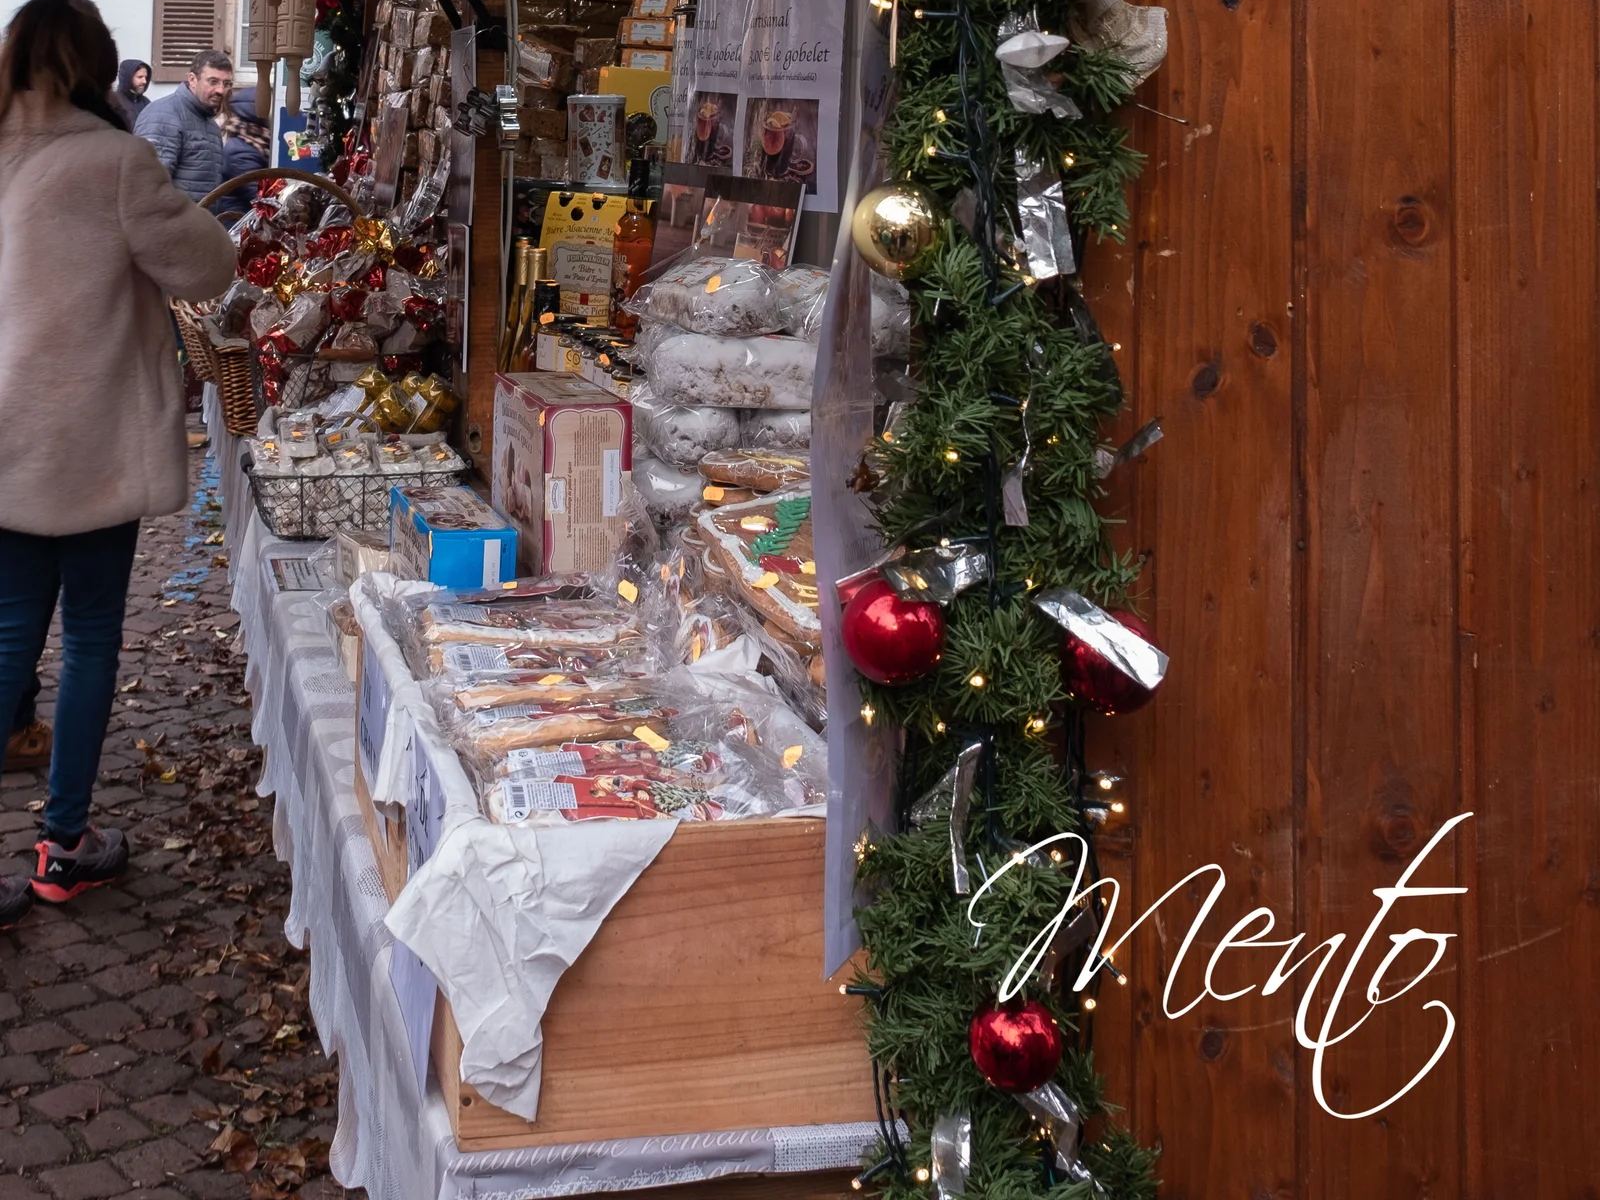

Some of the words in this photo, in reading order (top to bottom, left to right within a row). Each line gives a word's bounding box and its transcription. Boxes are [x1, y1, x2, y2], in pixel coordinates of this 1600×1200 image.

[750, 7, 792, 29] artisanal
[773, 42, 781, 62] le
[783, 42, 830, 71] gobelet
[546, 226, 563, 235] Bière
[565, 223, 602, 234] Alsacienne
[567, 254, 611, 266] FORTWENGER
[579, 264, 596, 273] Bière
[564, 302, 580, 314] Saint
